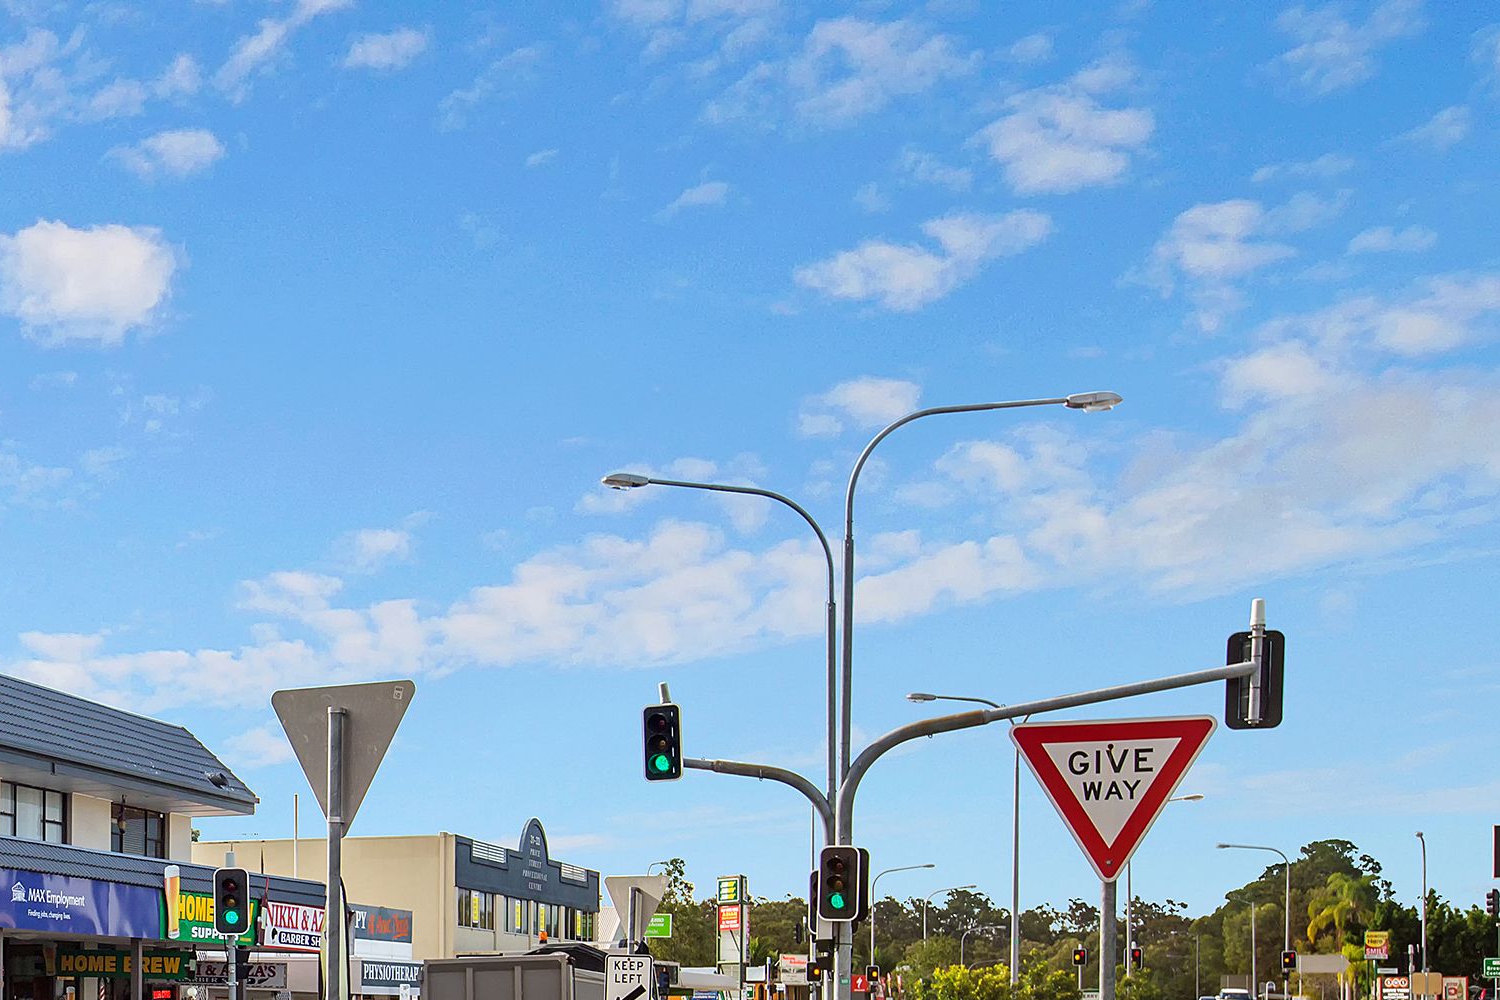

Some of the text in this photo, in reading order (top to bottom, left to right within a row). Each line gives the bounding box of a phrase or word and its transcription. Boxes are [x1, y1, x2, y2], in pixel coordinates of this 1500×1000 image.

[1068, 747, 1154, 776] GIVE
[1082, 779, 1142, 801] WAY
[28, 887, 86, 909] MAX Employment
[179, 894, 214, 923] HOME
[265, 903, 300, 930] NIKKI
[301, 910, 310, 931] &
[191, 926, 238, 941] SUPPS
[280, 932, 309, 946] BARBER
[60, 954, 181, 974] HOME BREW
[220, 964, 276, 978] AZA'S
[614, 960, 644, 971] KEEP
[614, 974, 642, 984] LEFT
